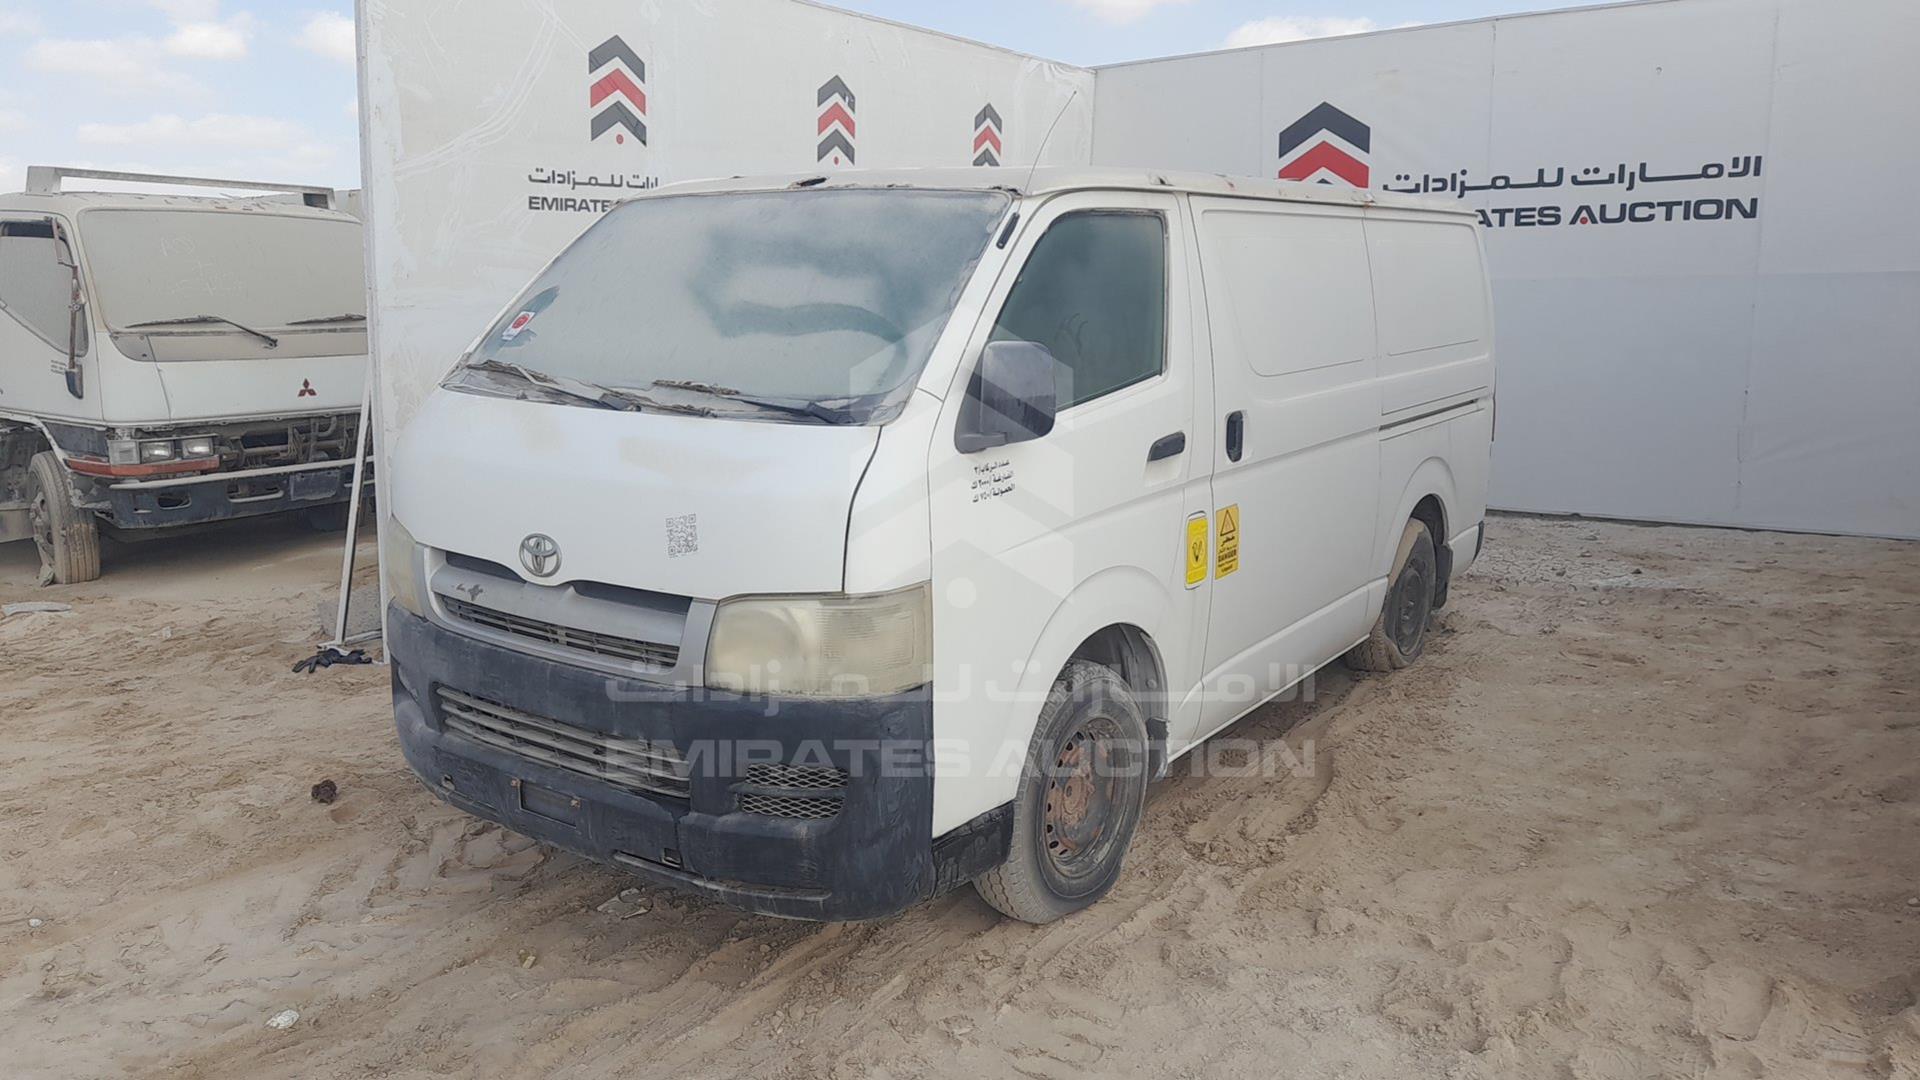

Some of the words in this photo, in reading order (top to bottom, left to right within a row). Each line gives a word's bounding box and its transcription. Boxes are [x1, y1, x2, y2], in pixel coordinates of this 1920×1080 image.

[528, 195, 611, 213] EMIRATE
[1475, 206, 1562, 228] ATES
[1569, 198, 1758, 225] AUCTION
